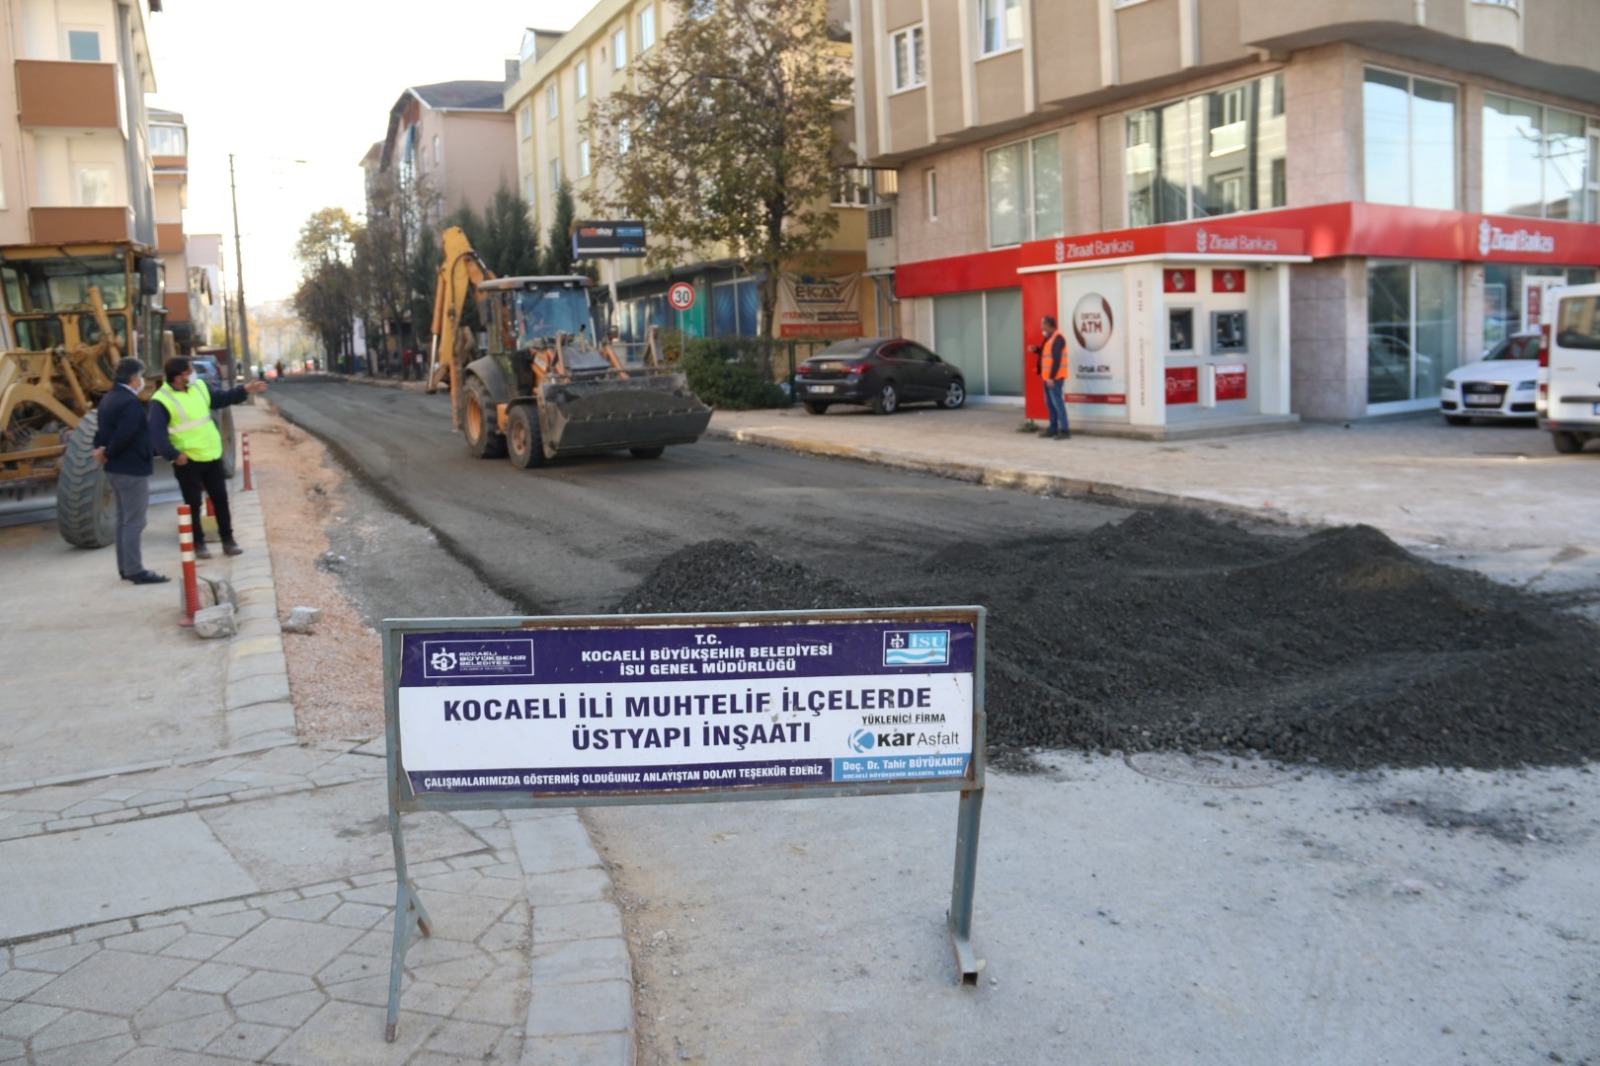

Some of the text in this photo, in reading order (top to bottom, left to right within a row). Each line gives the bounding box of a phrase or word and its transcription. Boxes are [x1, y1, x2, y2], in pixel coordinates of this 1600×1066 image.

[1067, 239, 1134, 258] Ziraat Bankası
[1210, 234, 1278, 251] Ziraat Bankası
[674, 289, 690, 304] 30
[795, 286, 843, 298] EKAY
[1080, 321, 1102, 334] ATM
[695, 634, 722, 645] T.C.
[910, 631, 946, 648] İSU
[581, 644, 833, 662] KOCAELİ BÜYÜKŞEHİR BELEDİYESİ
[620, 658, 796, 676] İSU GENEL MÜDÜRLÜĞÜ
[444, 686, 931, 721] KOCAELİ İLİ MUHTELİF İLÇELERDE
[862, 712, 946, 726] YÜKLENİCİ FİRMA
[572, 720, 811, 751] ÜSTYAPI İNŞAATI
[916, 730, 959, 747] Asfalt
[842, 760, 864, 772] Doç.
[867, 760, 881, 771] Dr.
[883, 758, 906, 770] Tahir
[424, 762, 823, 790] ÇALIŞMALARIMIZDA GÖSTERMİŞ OLDUĞUNUZ ANLAYIŞTAN DOLAYI TEŞEKKÜR EDERİZ
